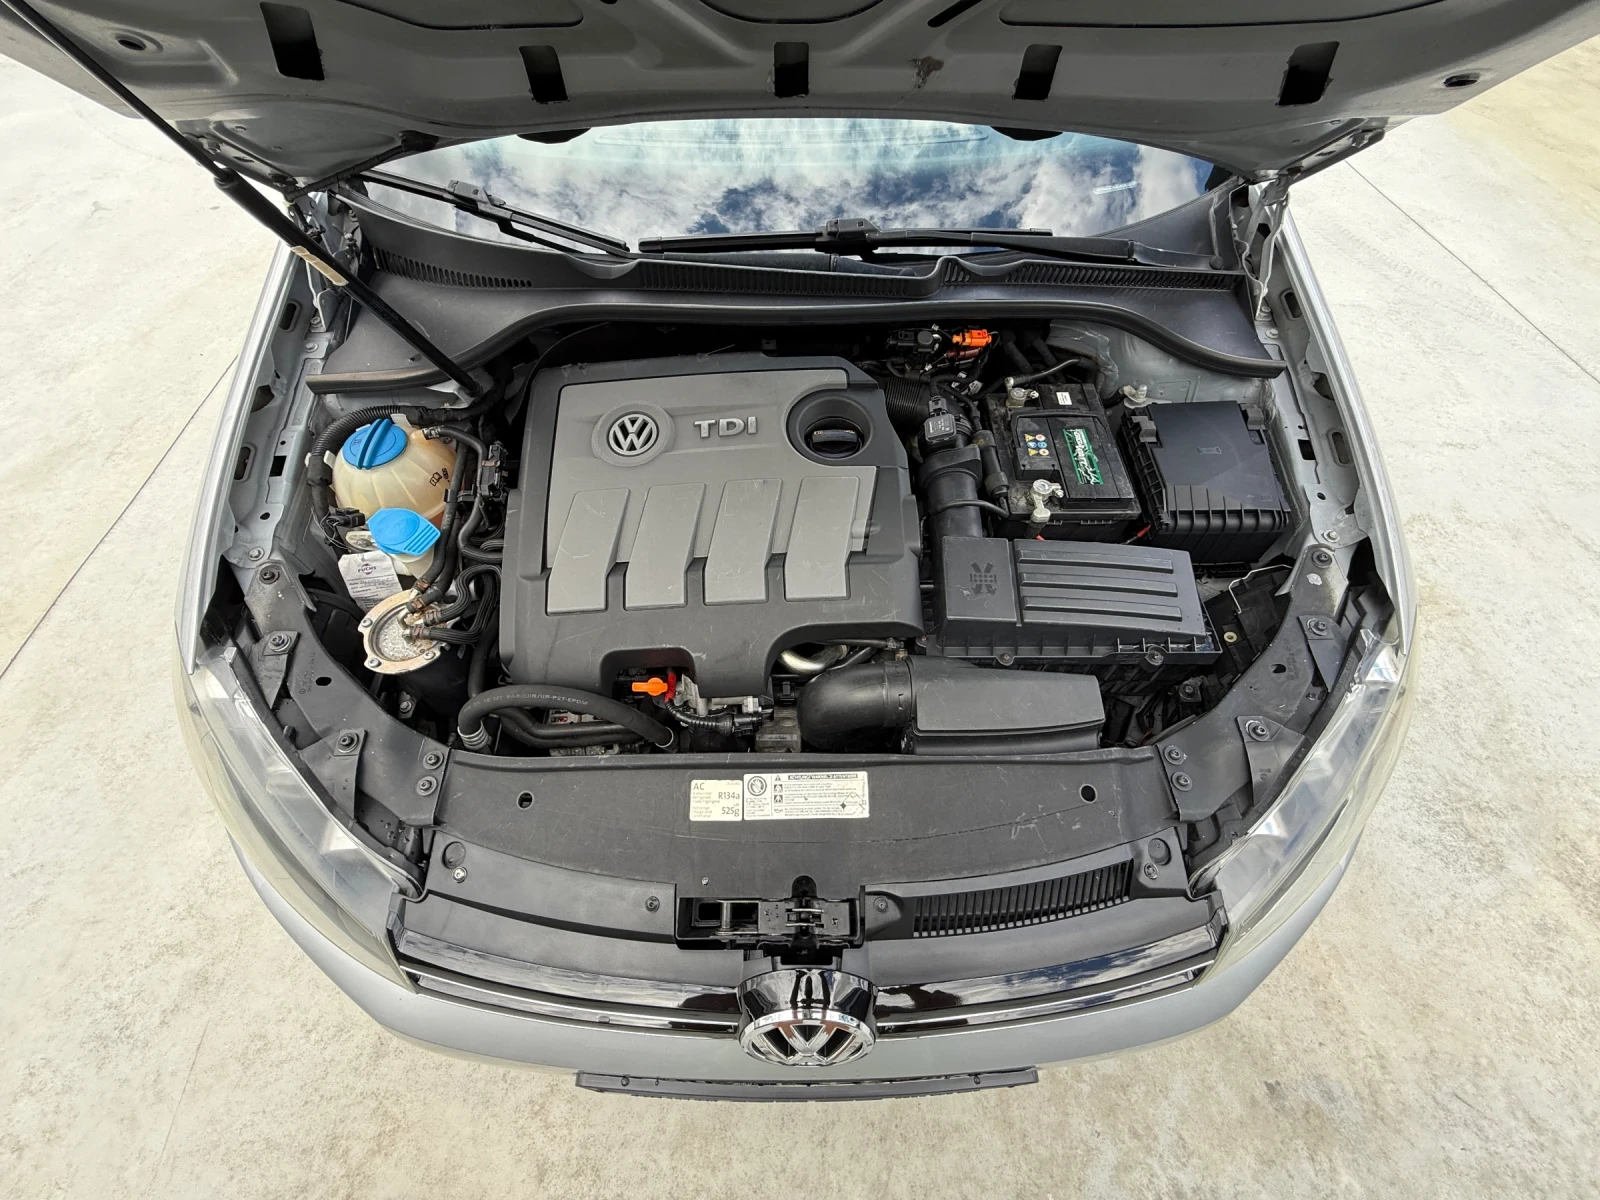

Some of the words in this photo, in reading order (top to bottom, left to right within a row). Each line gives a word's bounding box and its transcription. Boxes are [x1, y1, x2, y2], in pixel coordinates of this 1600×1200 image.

[694, 416, 758, 439] TDI
[693, 782, 705, 790] AC
[718, 791, 740, 800] R134a
[721, 806, 740, 817] 525g
